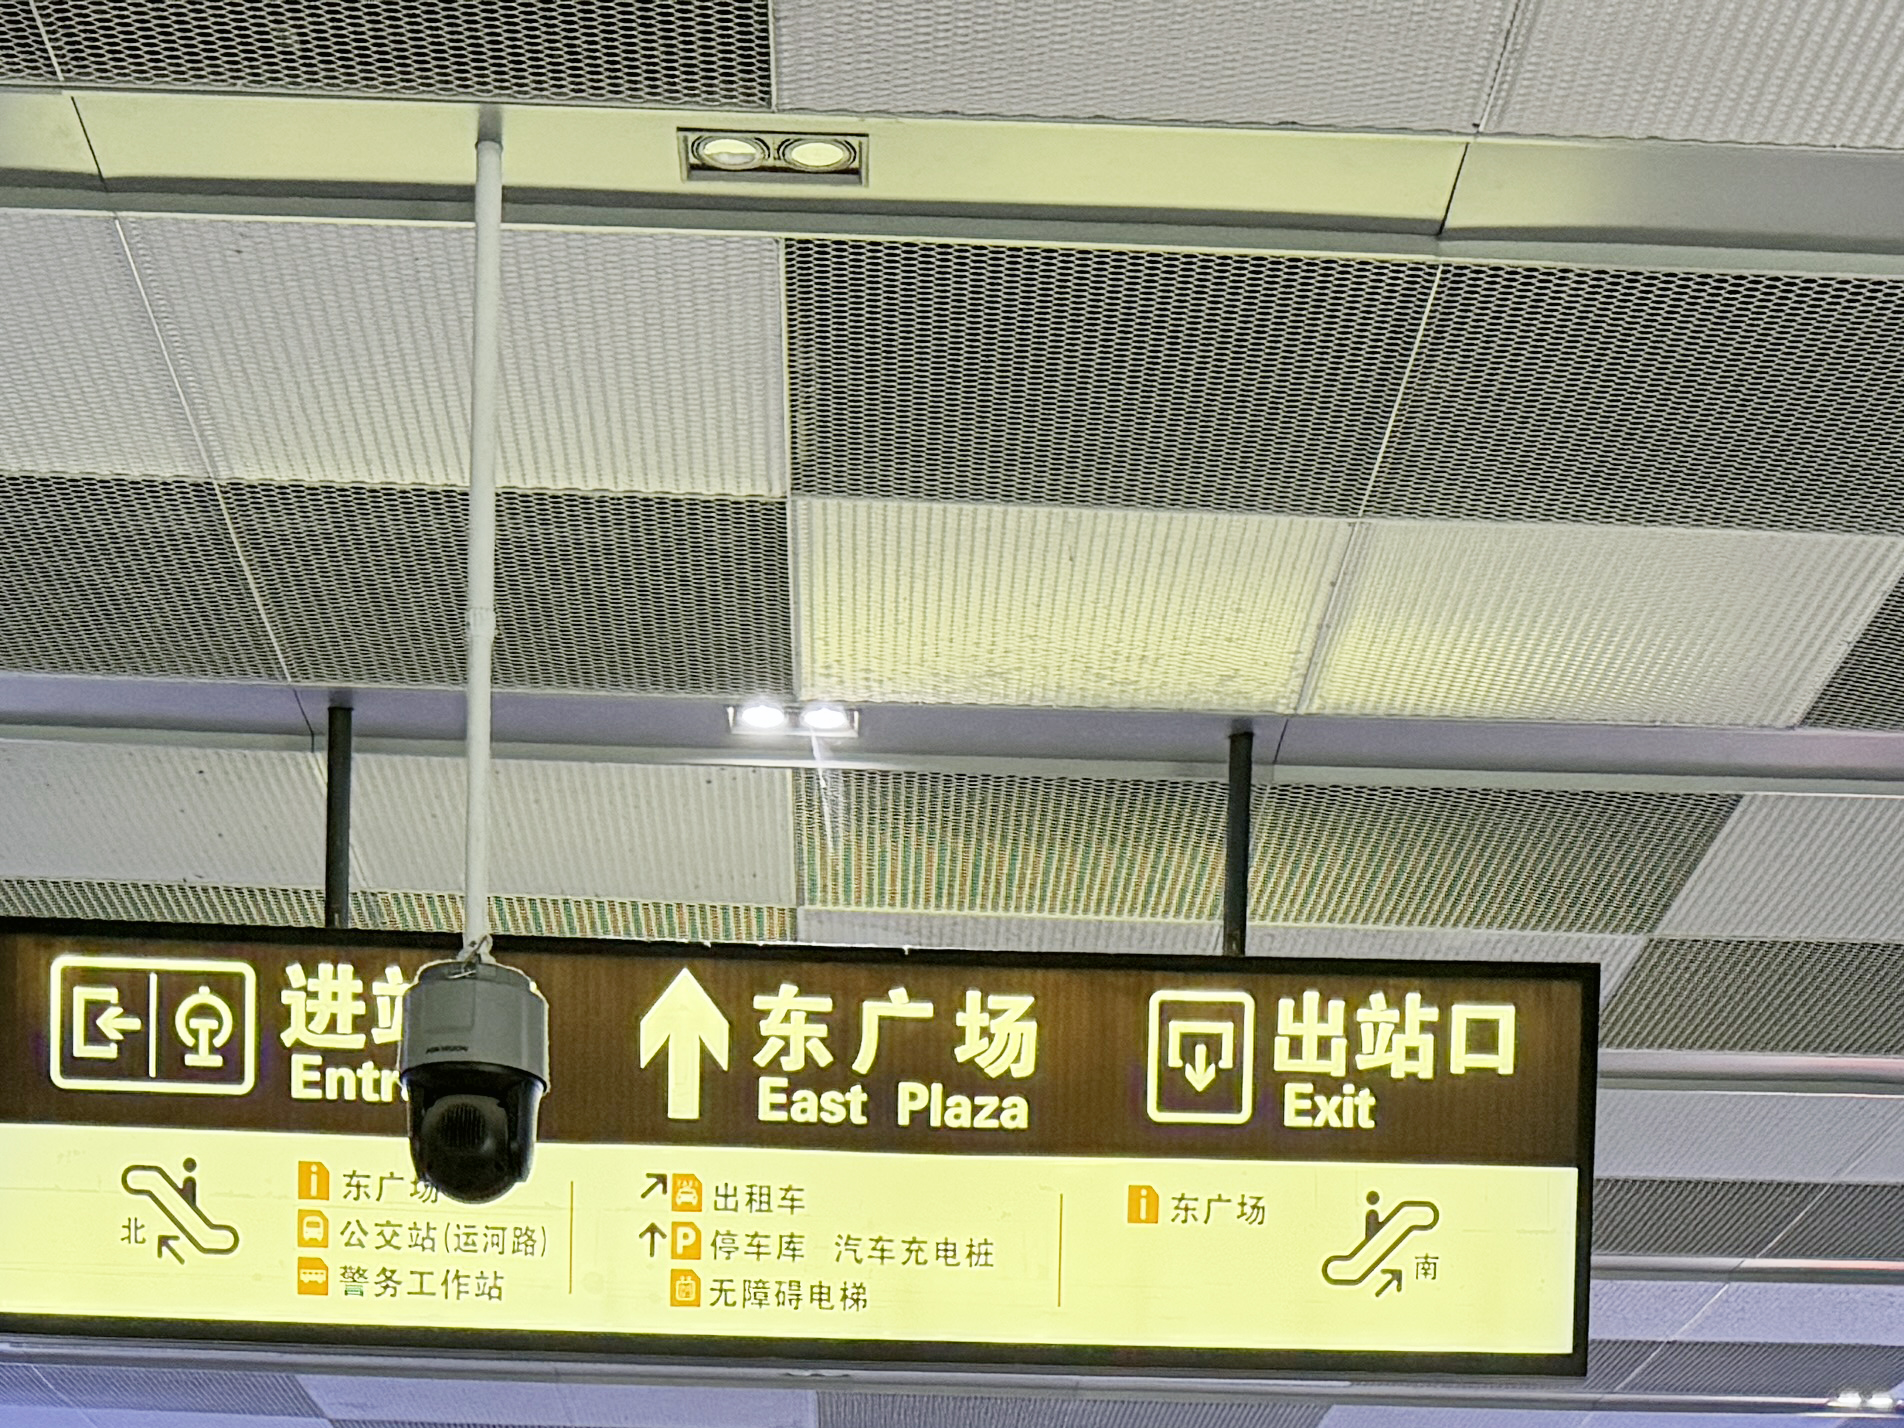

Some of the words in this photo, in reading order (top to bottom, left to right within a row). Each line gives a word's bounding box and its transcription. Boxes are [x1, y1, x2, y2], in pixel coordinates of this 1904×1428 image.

[752, 984, 1038, 1083] 东广场
[1273, 990, 1516, 1080] 出站口
[758, 1077, 868, 1125] East
[897, 1079, 1029, 1130] Plaza
[1283, 1083, 1376, 1129] Exit
[343, 1170, 439, 1204] 东广场
[713, 1183, 806, 1215] 出租车
[1171, 1195, 1266, 1227] 东广场
[121, 1216, 147, 1244] 北
[340, 1219, 547, 1257] 公交站(运河路)
[711, 1230, 806, 1262] 停车库
[835, 1233, 995, 1268] 汽车充电桩
[340, 1265, 506, 1301] 警务工作站
[1414, 1253, 1440, 1283] 南
[709, 1279, 868, 1312] 无障碍电梯
